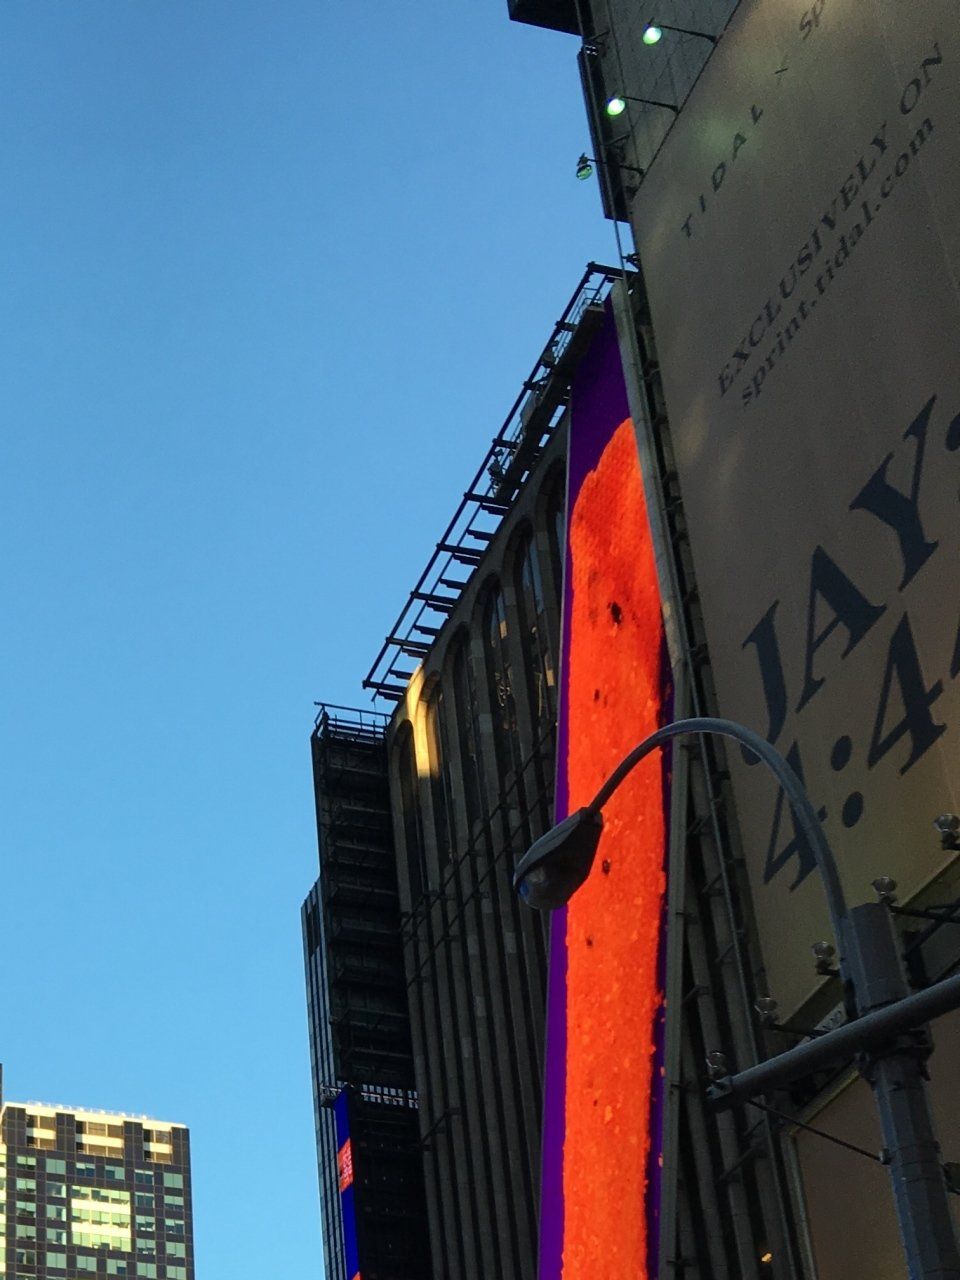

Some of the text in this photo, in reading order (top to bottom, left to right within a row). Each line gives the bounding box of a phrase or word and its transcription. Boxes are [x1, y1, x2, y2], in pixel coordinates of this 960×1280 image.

[681, 104, 763, 238] TIDAL
[718, 42, 943, 399] EXCLUSIVELY ON
[741, 117, 935, 408] sprint.tidal.com
[741, 394, 939, 766] JAY
